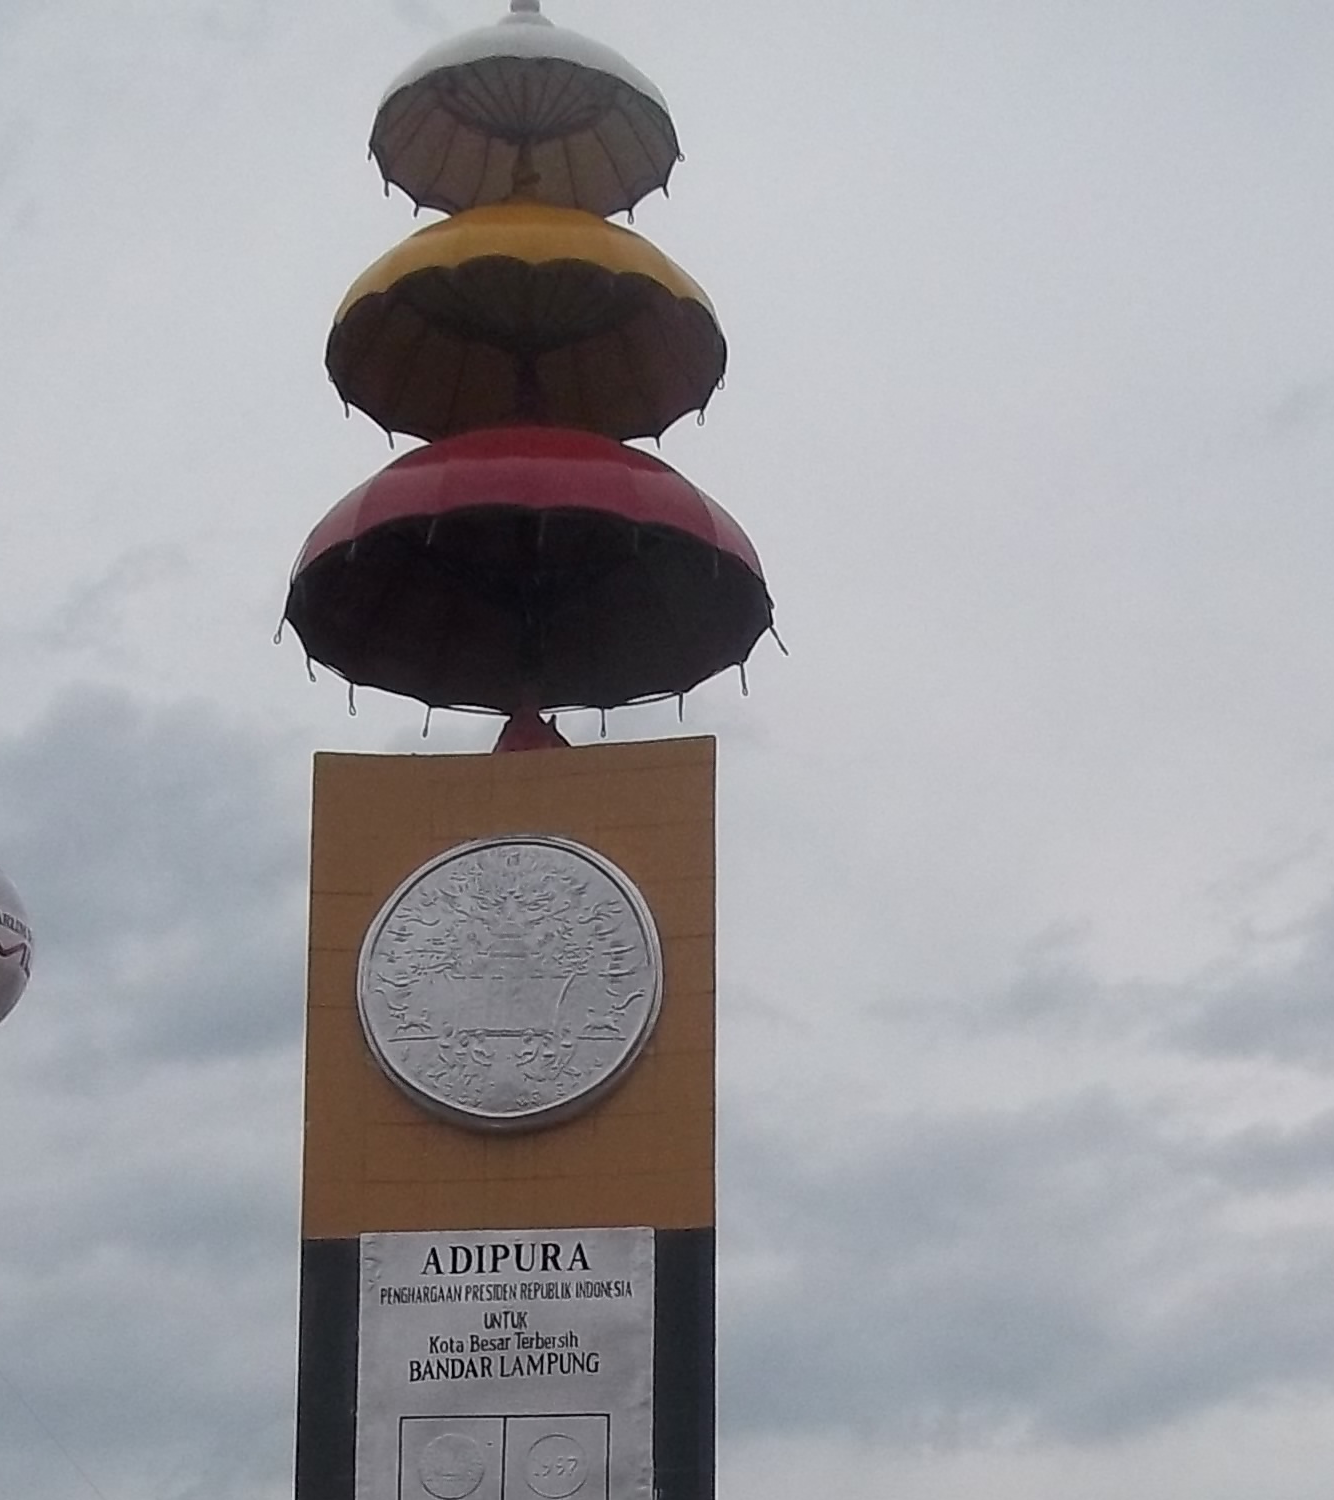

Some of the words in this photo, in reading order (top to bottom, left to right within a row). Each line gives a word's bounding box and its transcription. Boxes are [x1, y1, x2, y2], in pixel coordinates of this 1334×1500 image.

[420, 1241, 592, 1275] ADIPURA
[380, 1285, 463, 1305] PENGHARGAAN
[465, 1283, 517, 1302] PRESIDEN
[520, 1281, 572, 1300] REPUBLIK
[575, 1280, 633, 1299] INDONESIA
[484, 1310, 528, 1330] UNTUK
[428, 1335, 465, 1354] Kota
[470, 1334, 511, 1353] Besar
[515, 1331, 579, 1350] Terbersih
[409, 1355, 494, 1382] BANDAR
[499, 1352, 600, 1378] LAMPUNG
